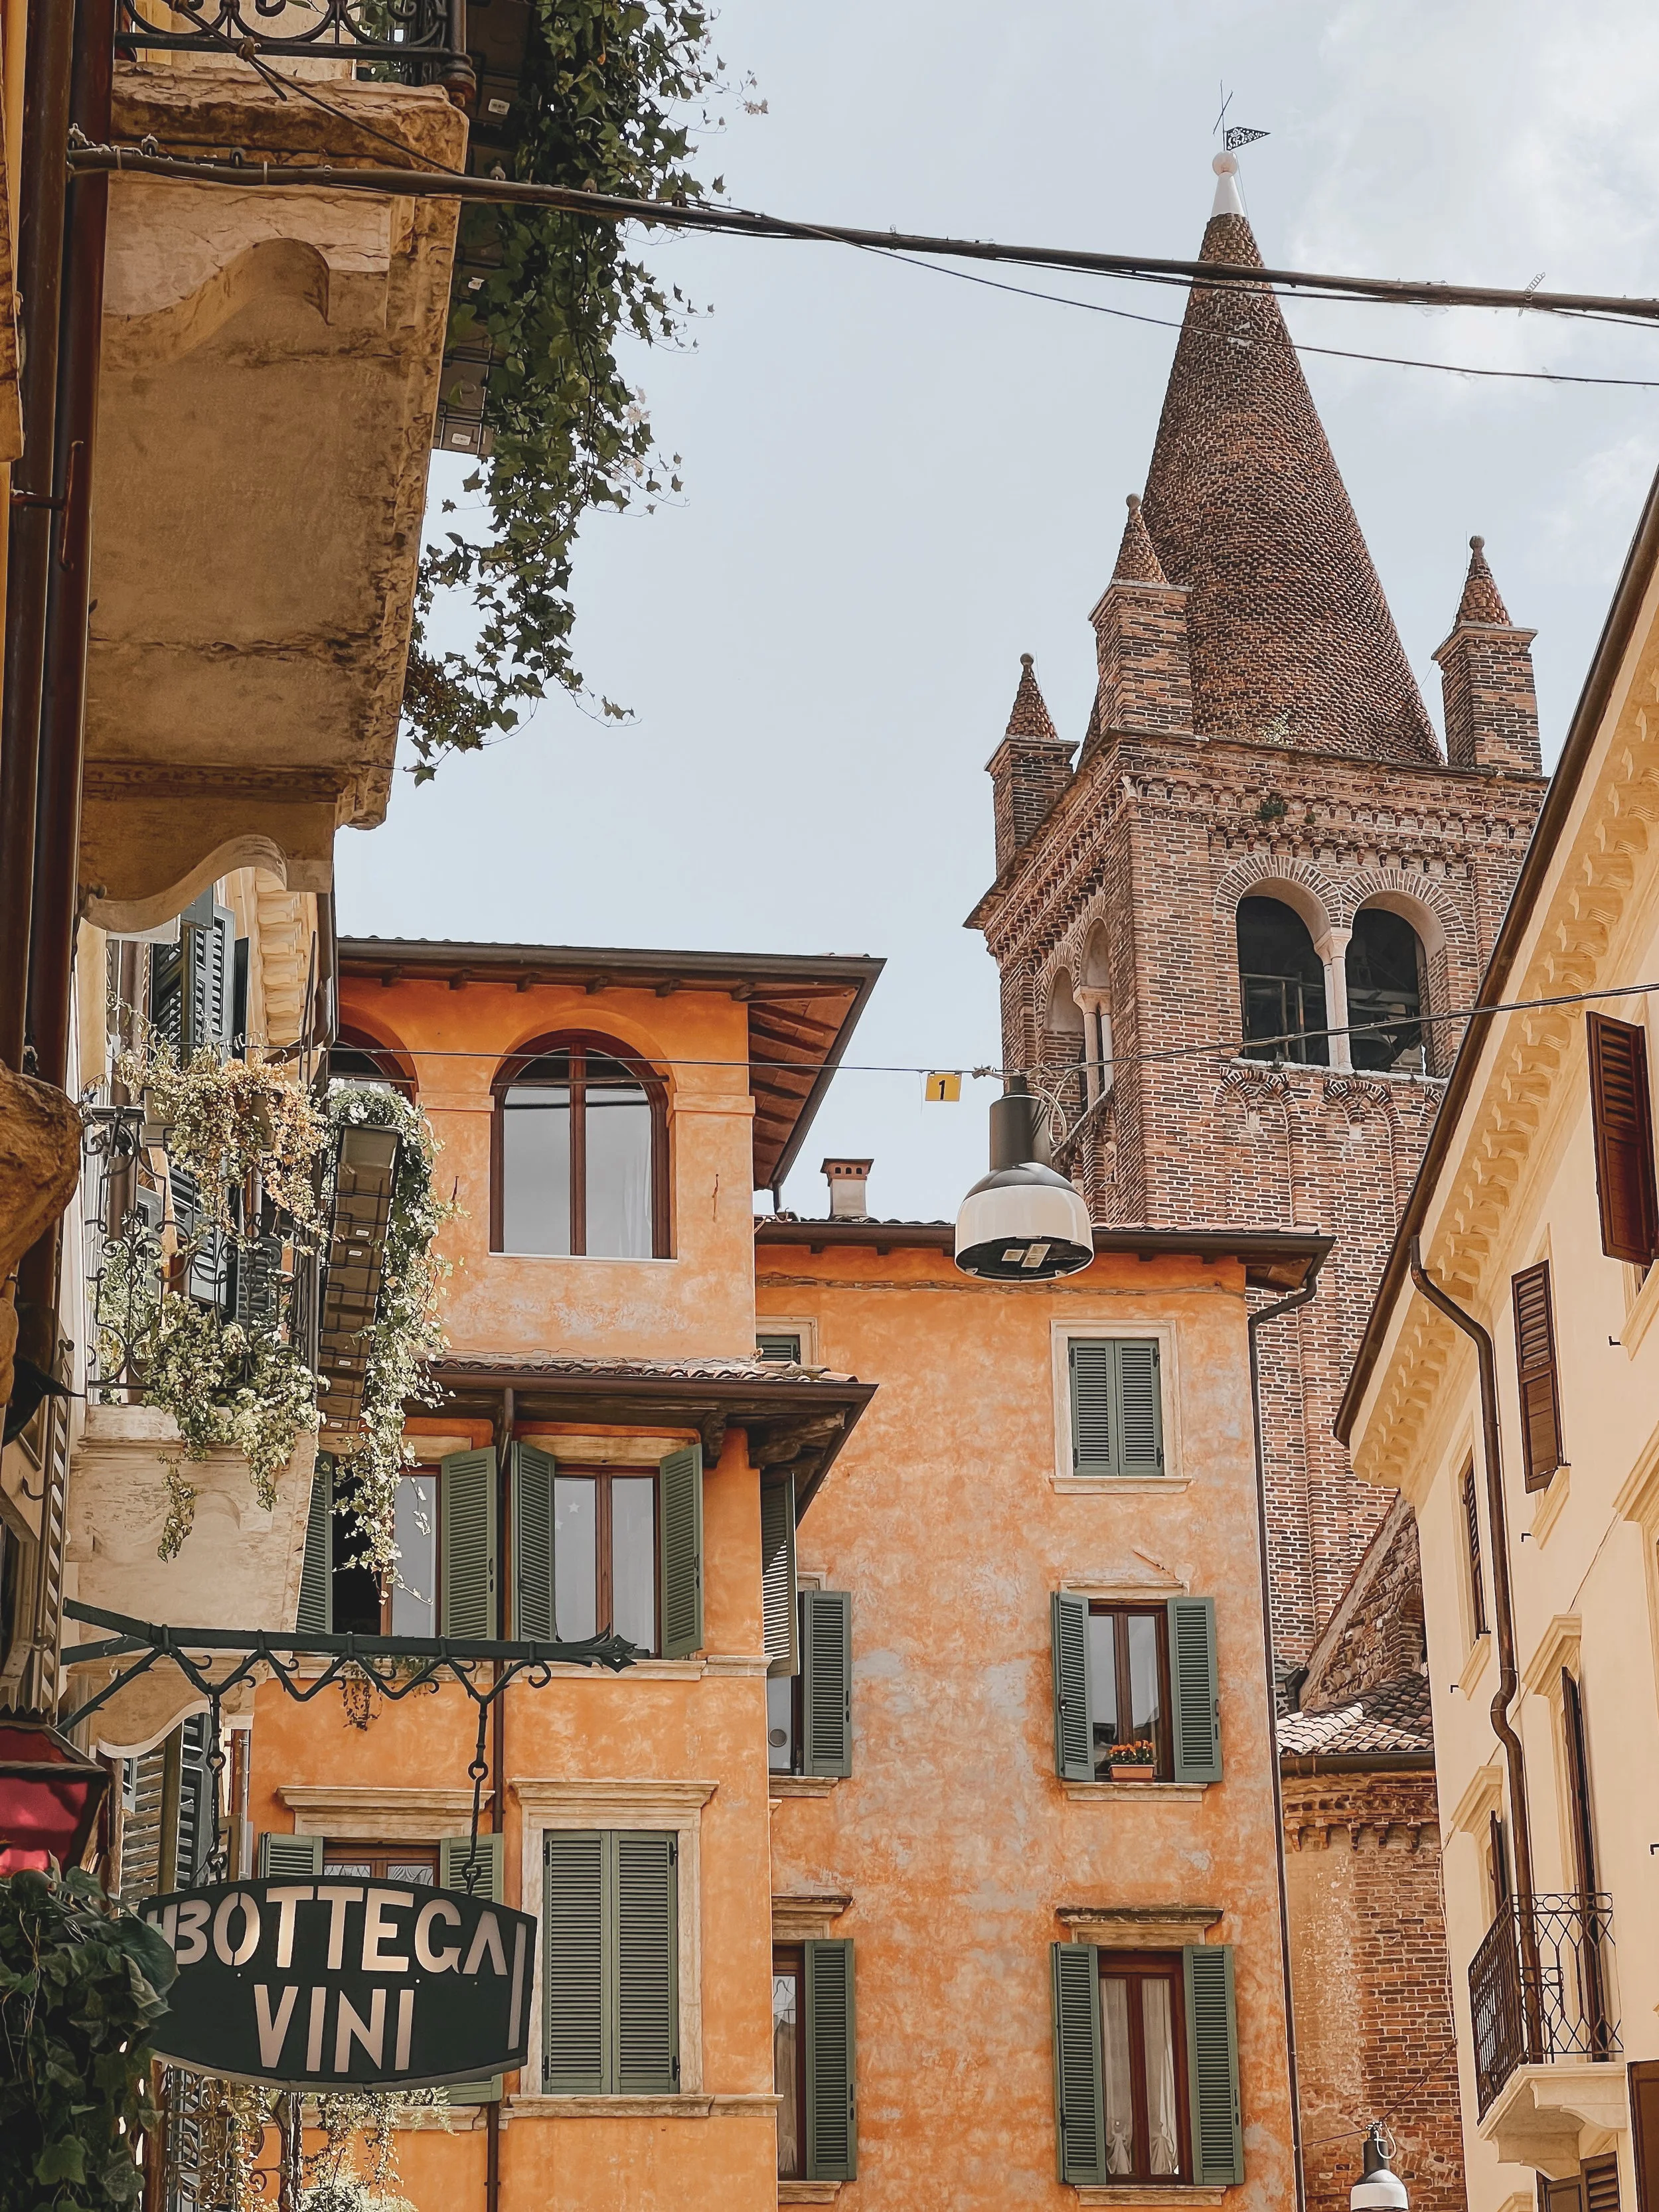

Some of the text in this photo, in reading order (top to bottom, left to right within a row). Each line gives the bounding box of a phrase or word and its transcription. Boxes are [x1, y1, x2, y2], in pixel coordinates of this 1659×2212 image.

[939, 1080, 946, 1100] 1
[161, 1885, 508, 1975] BOTTEGA
[254, 1984, 415, 2073] VINI
